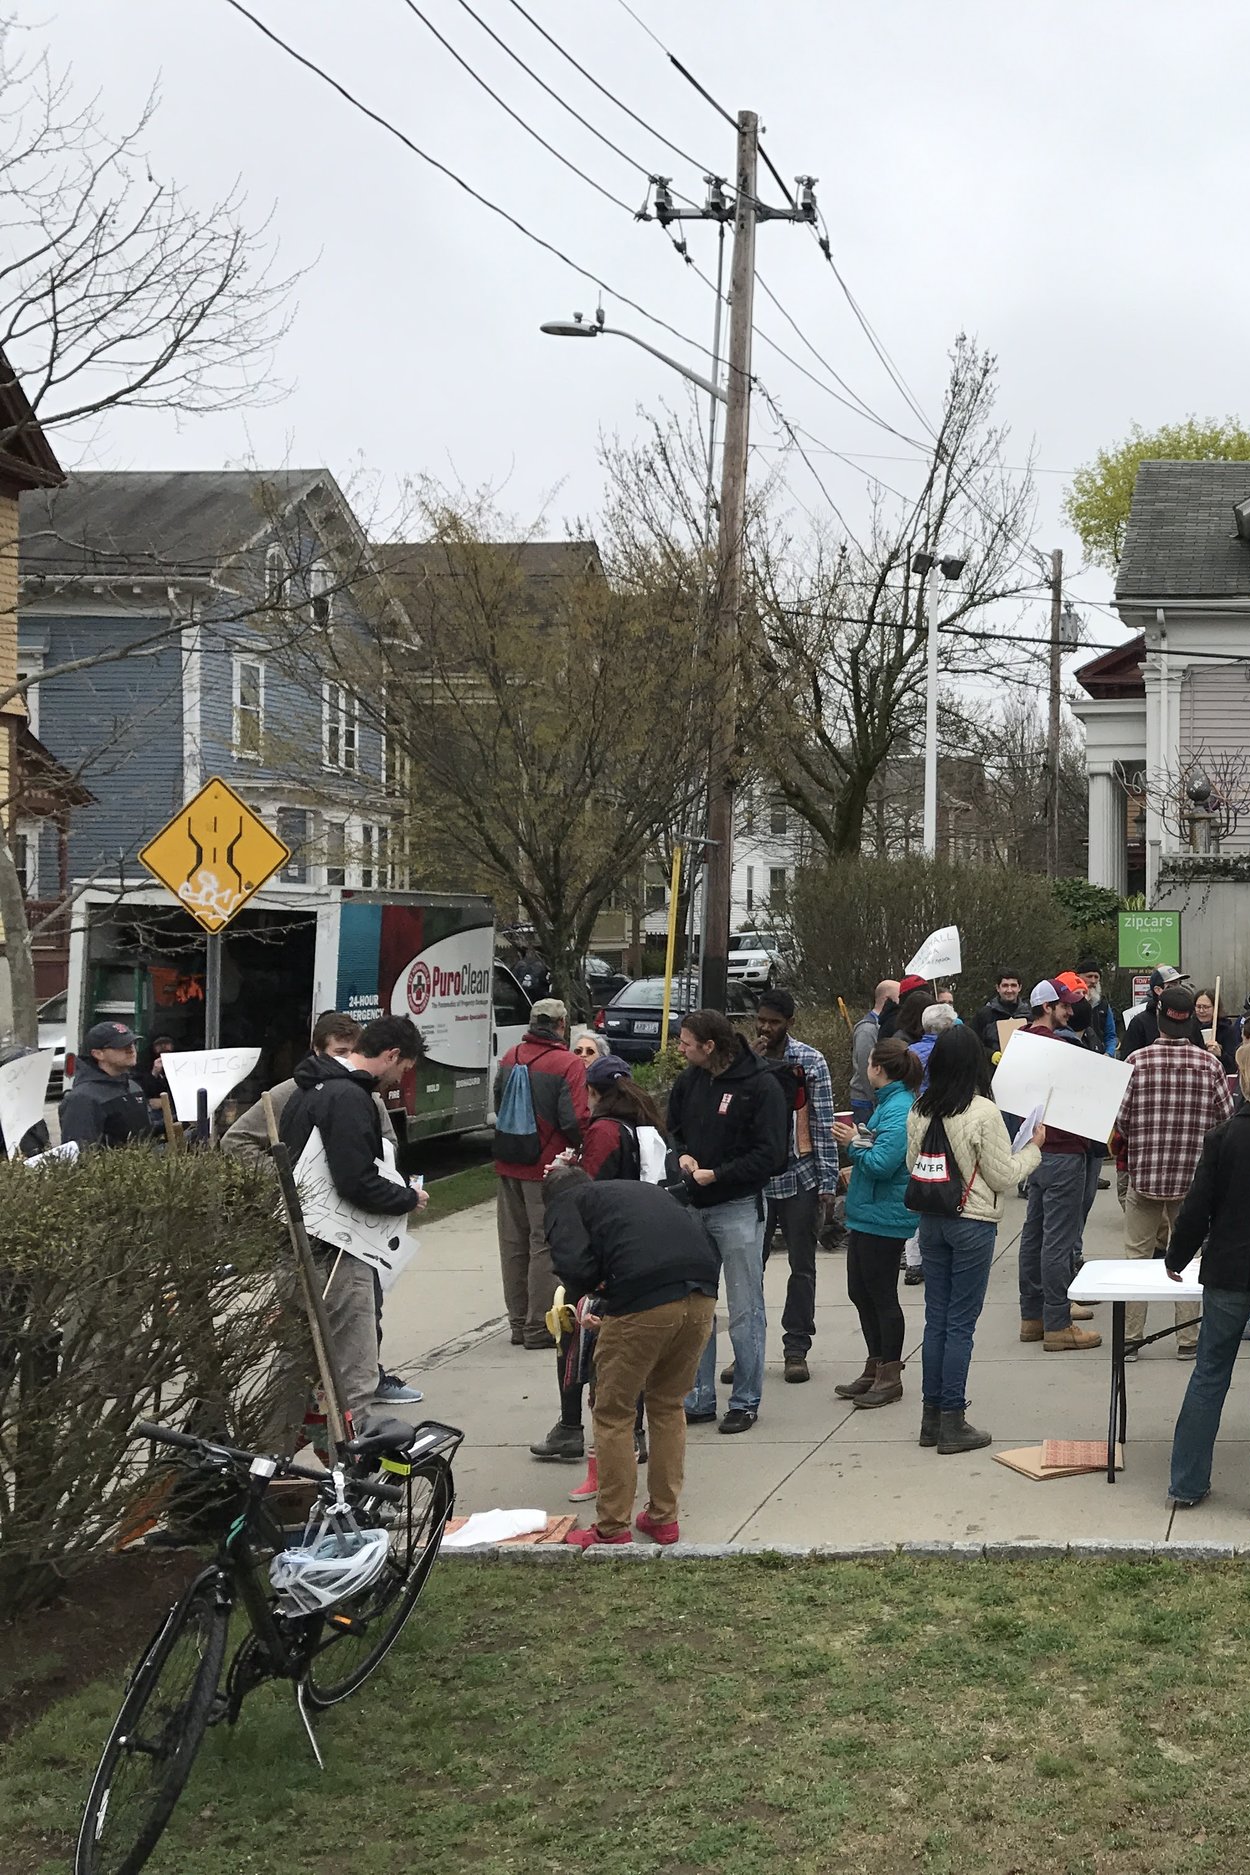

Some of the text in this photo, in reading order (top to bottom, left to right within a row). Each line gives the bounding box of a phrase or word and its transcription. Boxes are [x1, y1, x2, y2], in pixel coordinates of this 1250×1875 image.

[1124, 914, 1174, 930] zipcars
[432, 963, 489, 998] PuroClean
[348, 994, 379, 1007] 24-HOUR
